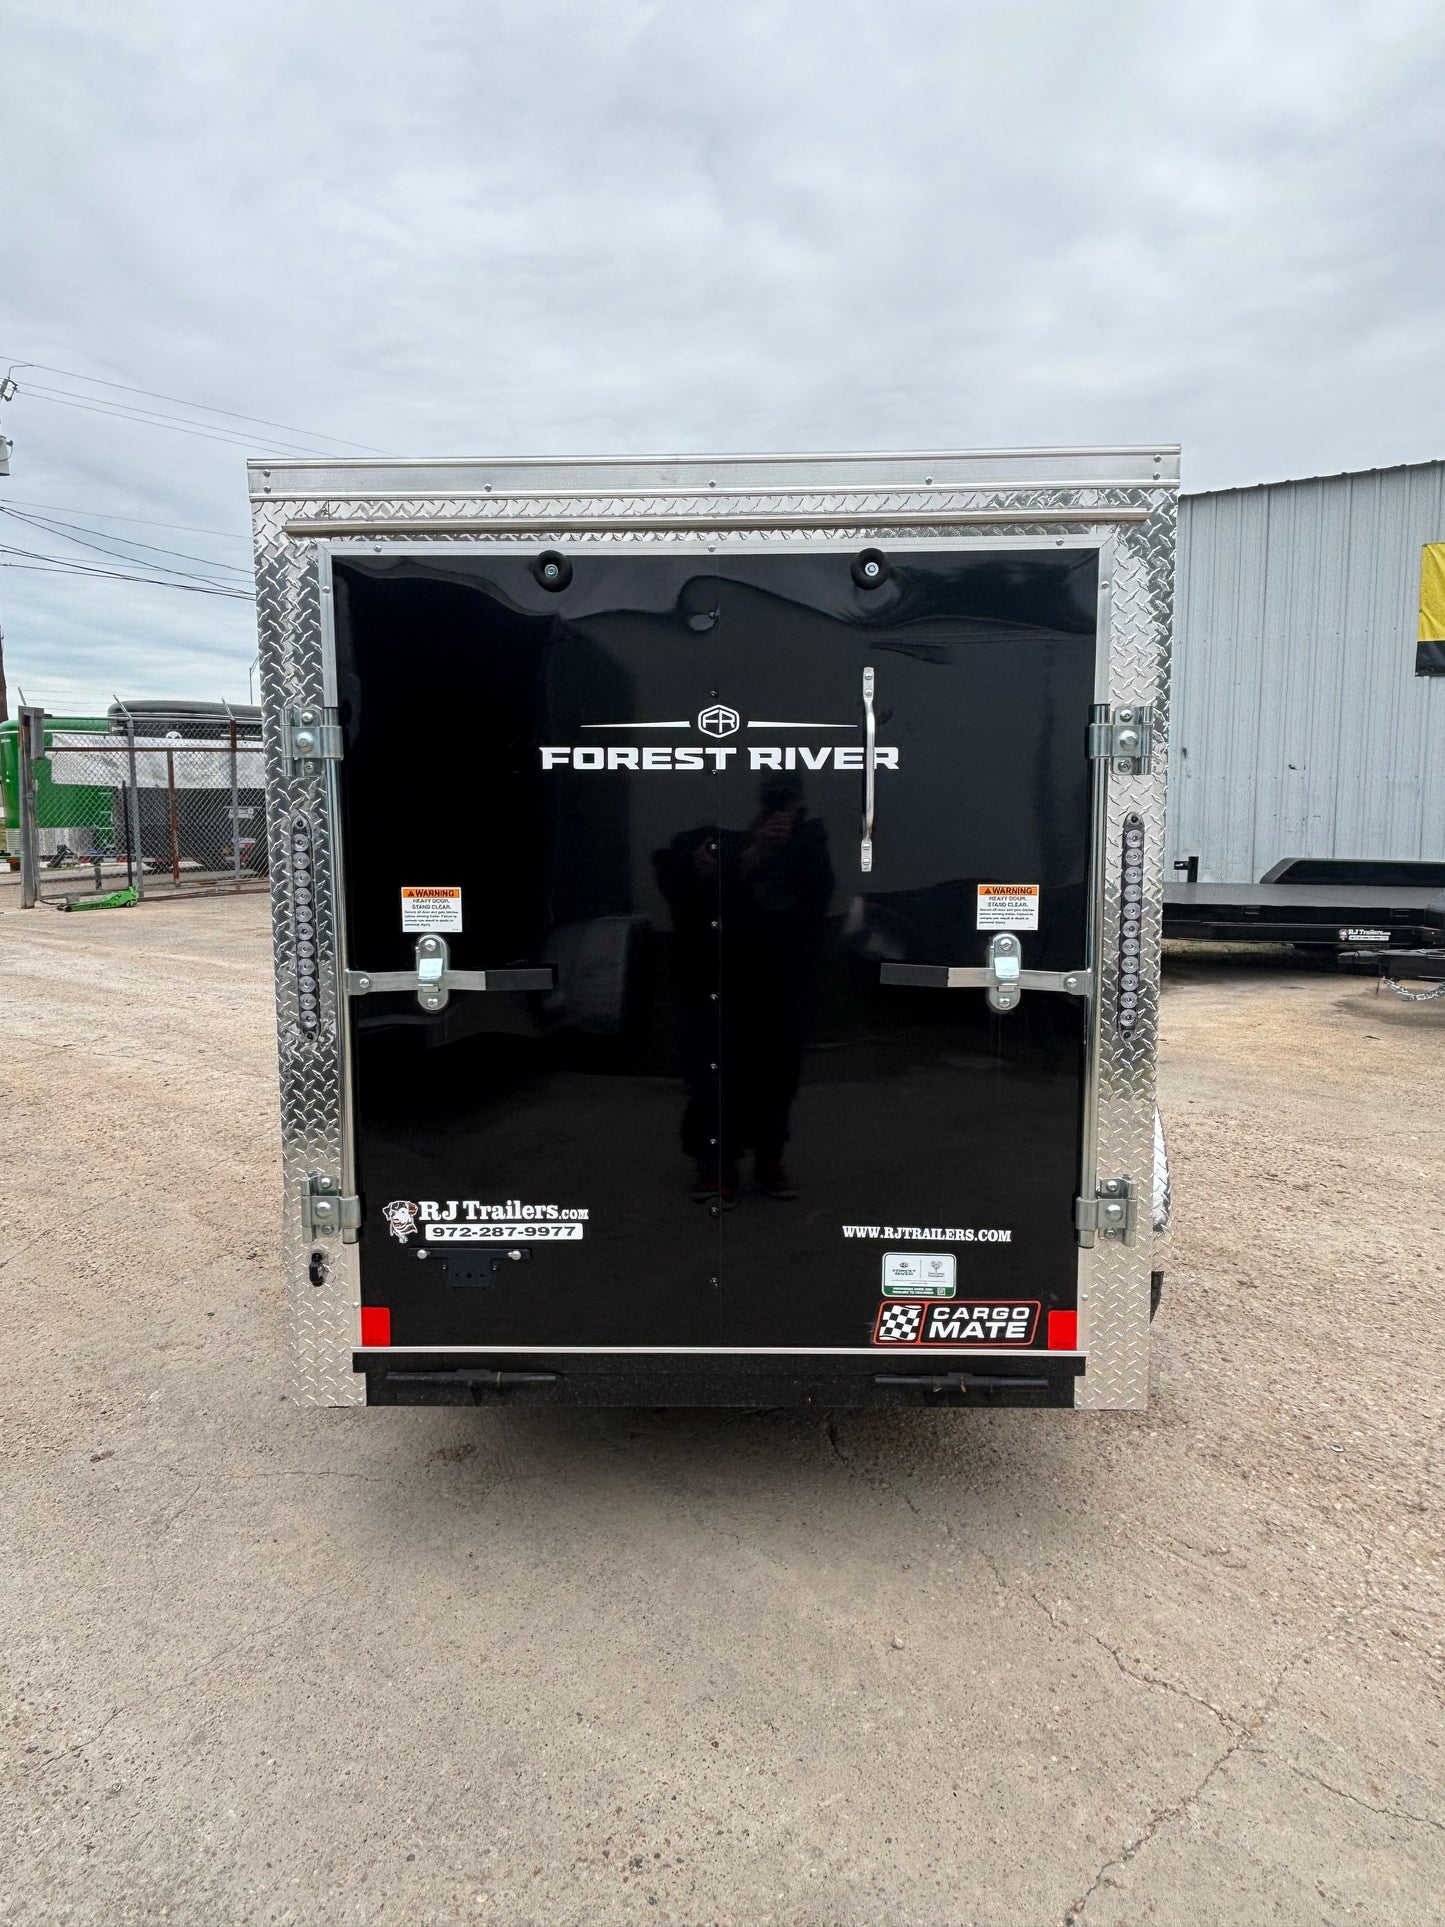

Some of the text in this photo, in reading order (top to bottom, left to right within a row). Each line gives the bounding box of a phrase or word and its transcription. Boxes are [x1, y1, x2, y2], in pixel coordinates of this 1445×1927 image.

[538, 746, 900, 770] FOREST RIVER
[415, 888, 455, 898] WARNING
[993, 886, 1033, 895] WARNING
[418, 1201, 459, 1221] RJ
[432, 1226, 577, 1238] 972-287-9977
[842, 1225, 1012, 1243] WWW.RJTRAILERS.COM
[933, 1307, 1030, 1321] CARGO
[929, 1322, 1025, 1339] MATE
